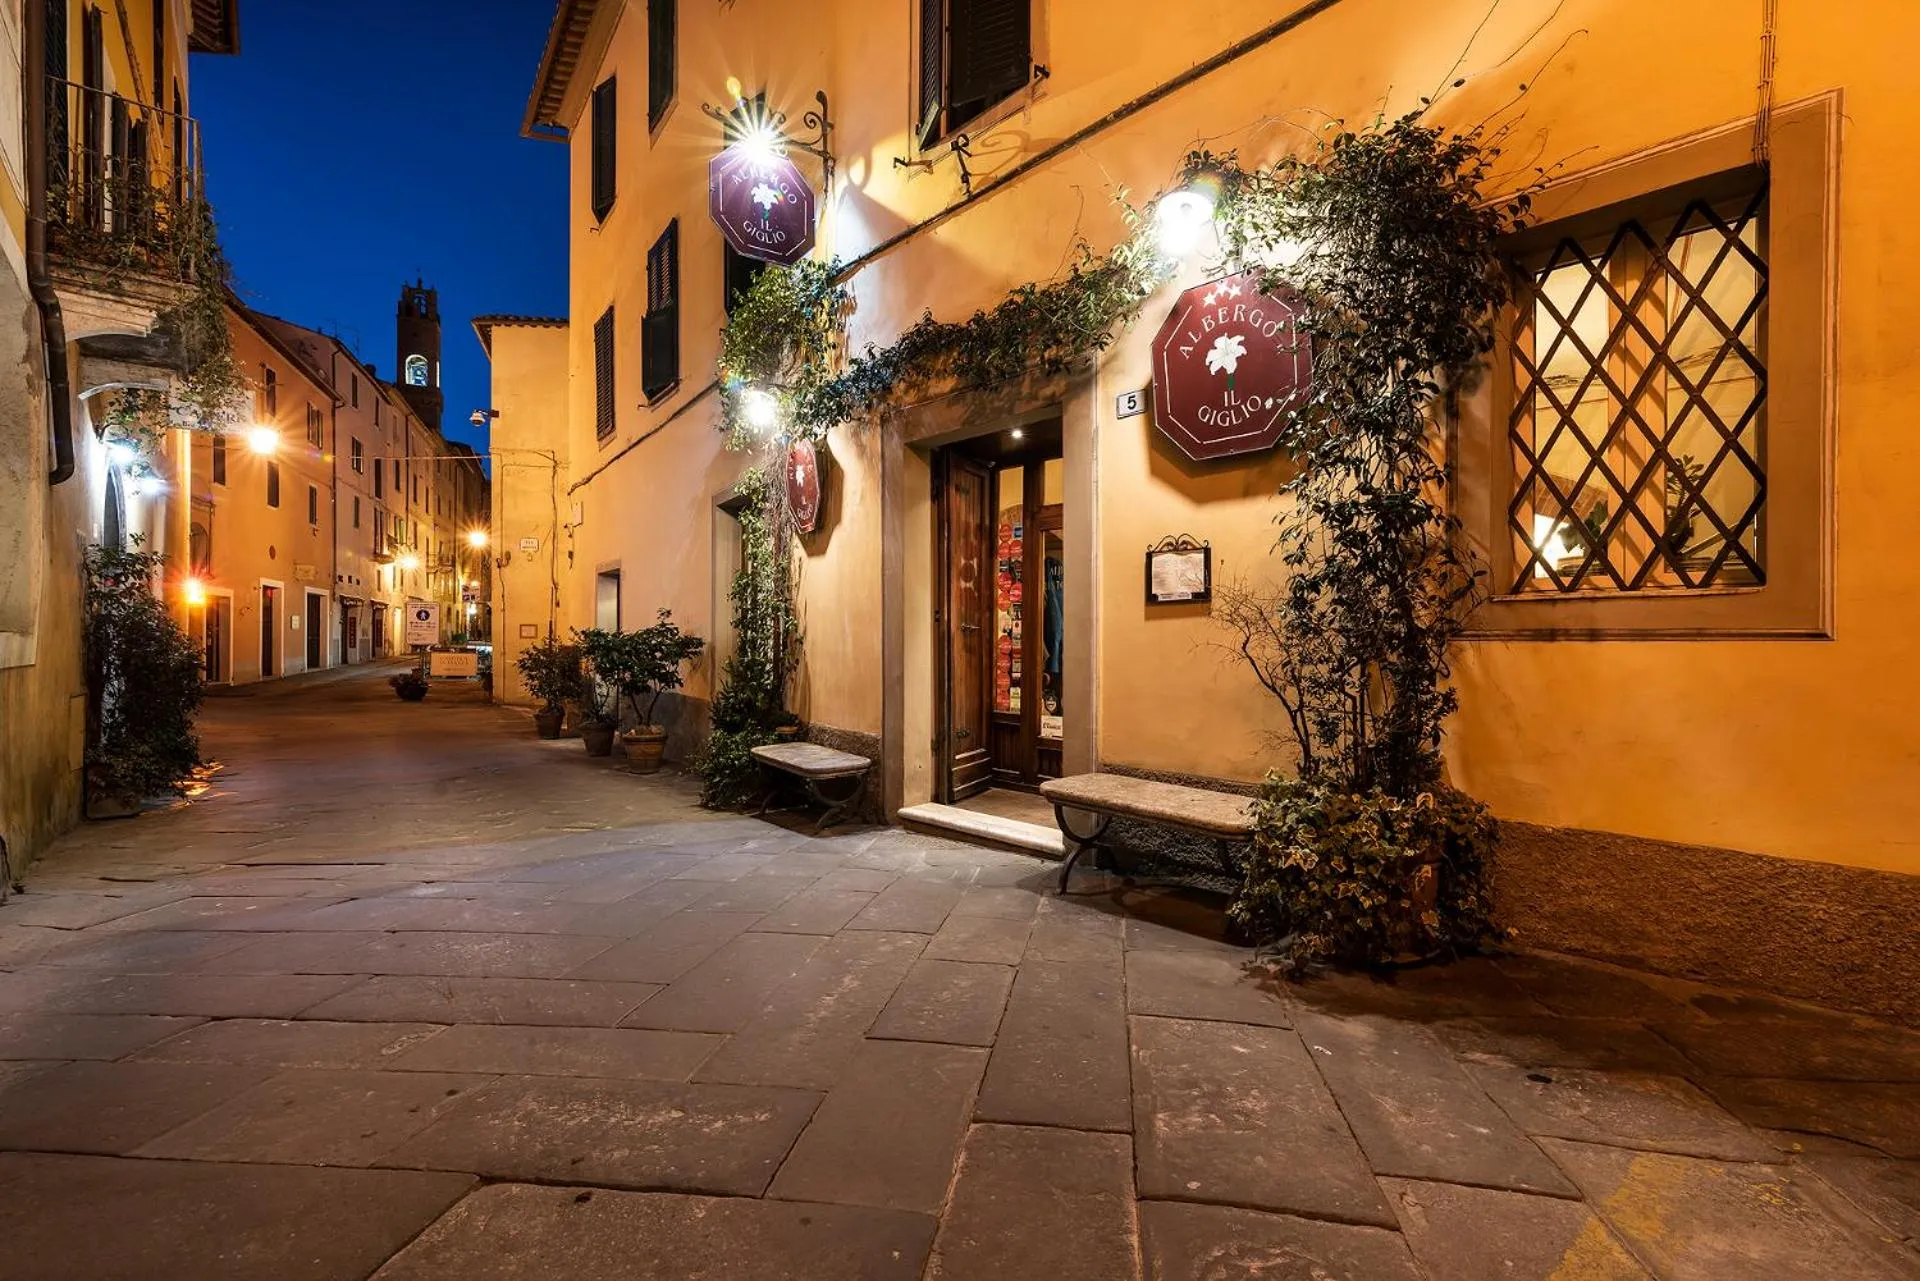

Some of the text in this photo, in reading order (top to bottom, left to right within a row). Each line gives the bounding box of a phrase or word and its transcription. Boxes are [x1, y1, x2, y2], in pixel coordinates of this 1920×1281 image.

[743, 220, 786, 244] GIGLIO
[760, 219, 772, 231] IL
[1179, 303, 1277, 360] ALBERGO
[1127, 395, 1137, 410] 5
[1224, 390, 1240, 407] IL
[1198, 395, 1262, 427] GIGLIO
